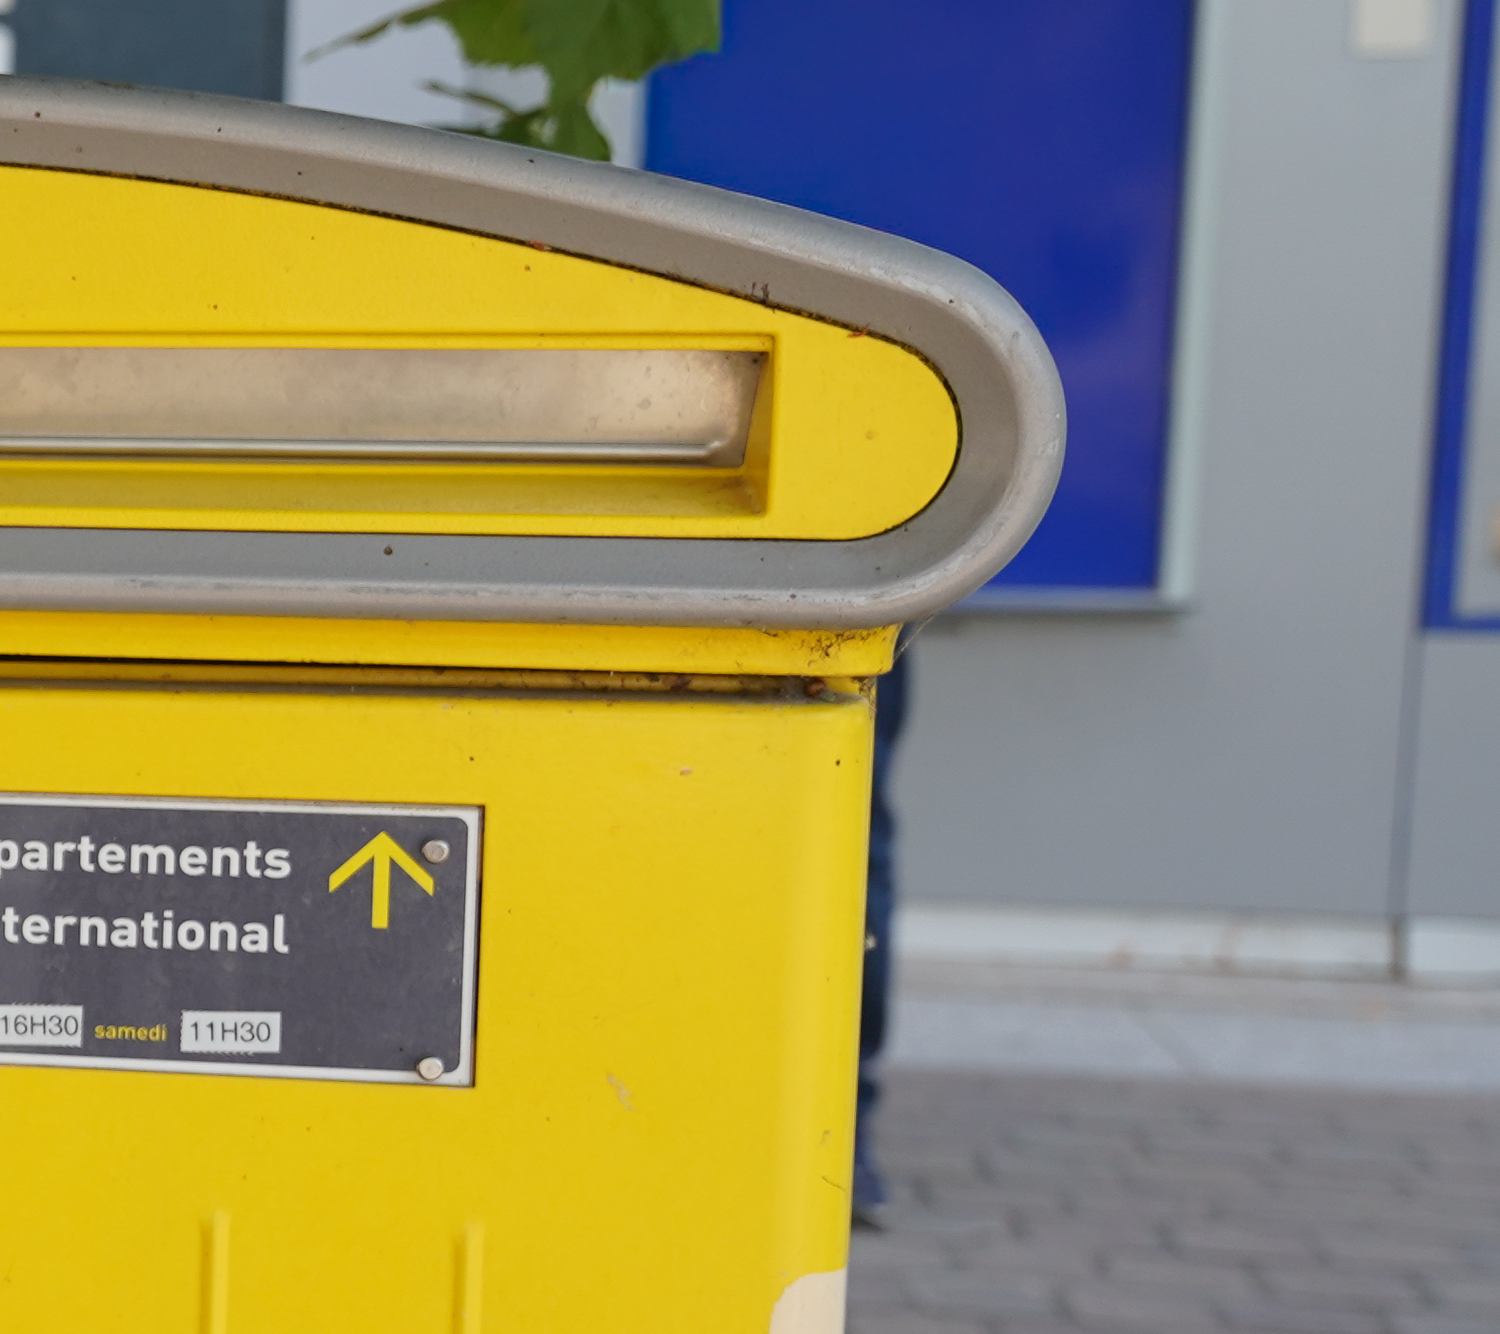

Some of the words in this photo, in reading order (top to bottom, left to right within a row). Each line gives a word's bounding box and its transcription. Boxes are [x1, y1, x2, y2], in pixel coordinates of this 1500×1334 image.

[0, 1014, 80, 1037] 16H30
[93, 1023, 169, 1043] samedi
[189, 1020, 272, 1043] 11H30
